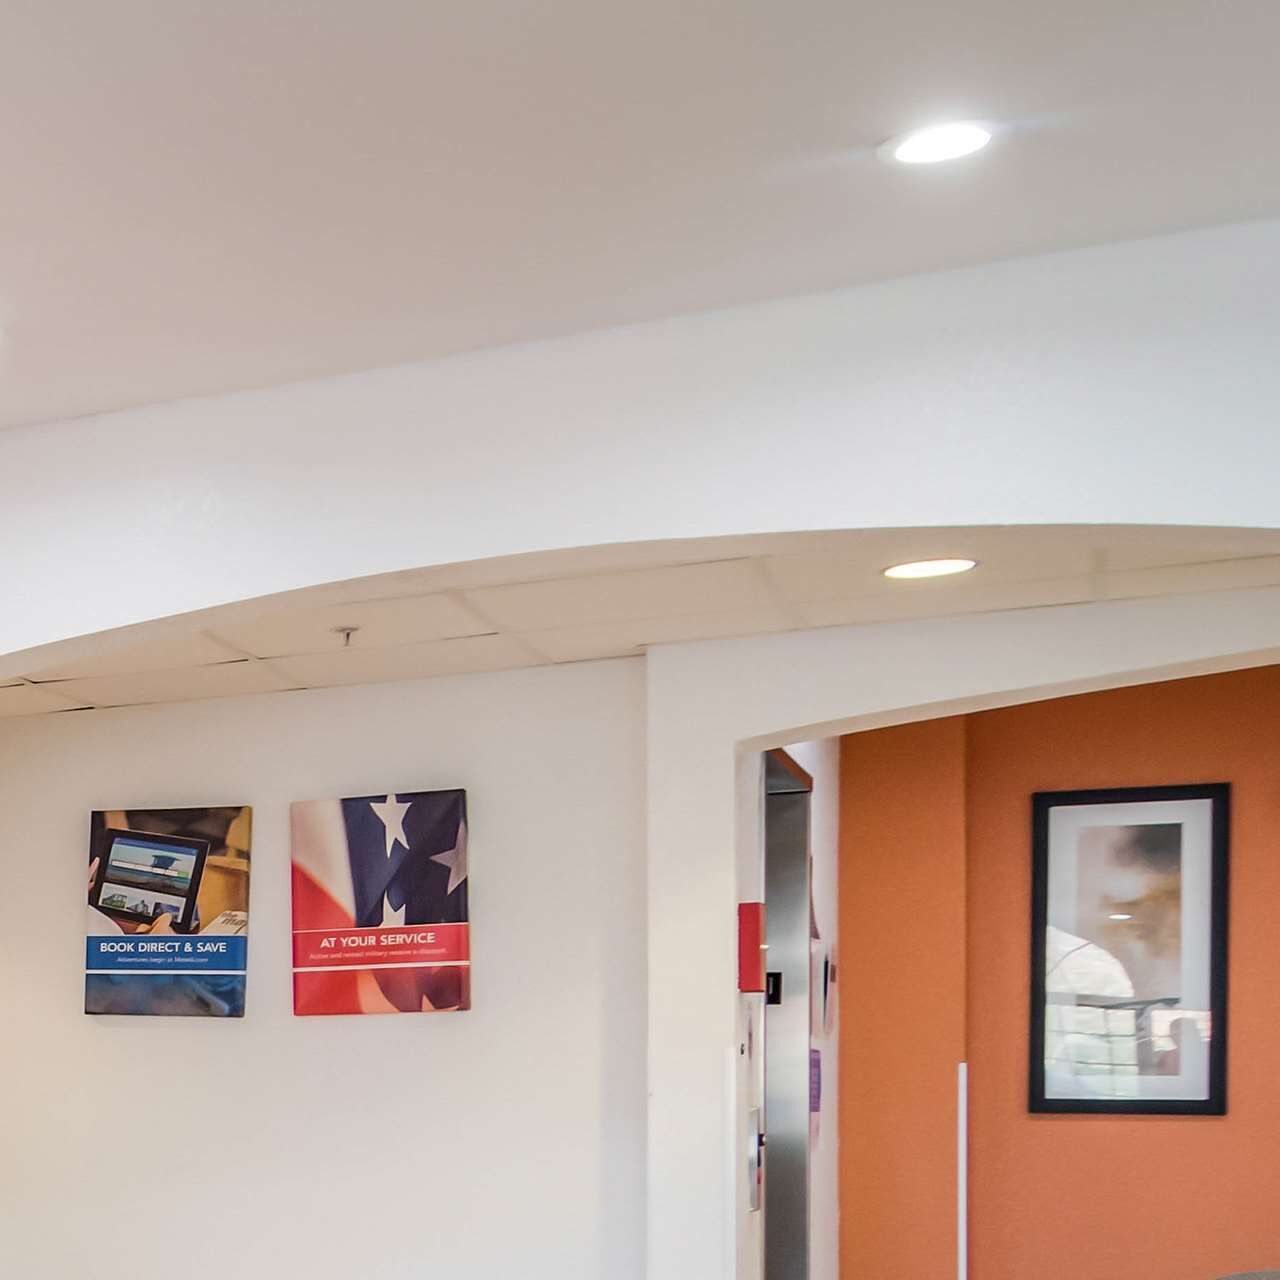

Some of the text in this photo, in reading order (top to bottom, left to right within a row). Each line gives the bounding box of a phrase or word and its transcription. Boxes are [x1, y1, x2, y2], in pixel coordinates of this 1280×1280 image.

[100, 942, 227, 953] BOOK DIRECT & SAVE
[320, 932, 436, 949] AT YOUR SERVICE
